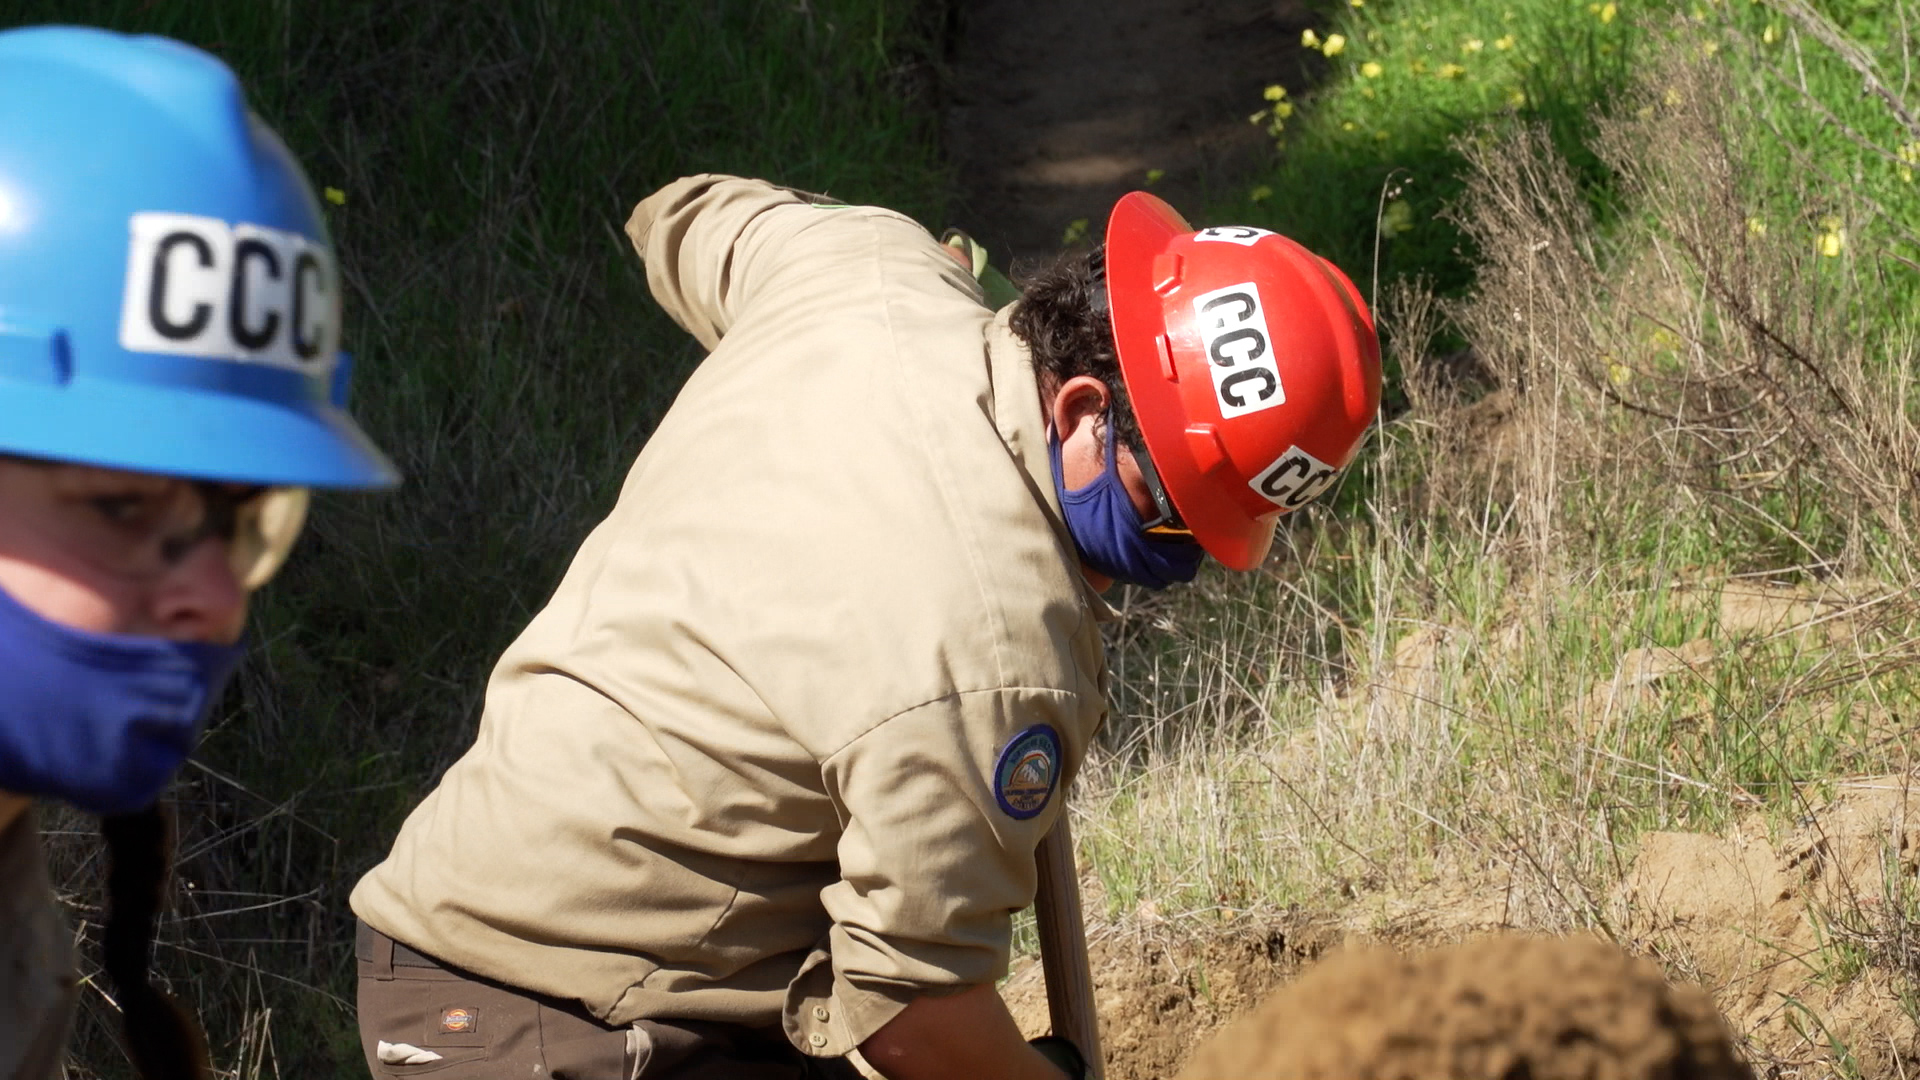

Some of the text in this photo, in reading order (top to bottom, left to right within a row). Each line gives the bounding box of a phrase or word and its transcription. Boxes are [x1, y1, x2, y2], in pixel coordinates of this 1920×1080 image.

[148, 231, 324, 360] CCC
[1201, 291, 1277, 408] CCC
[1260, 456, 1337, 507] CC
